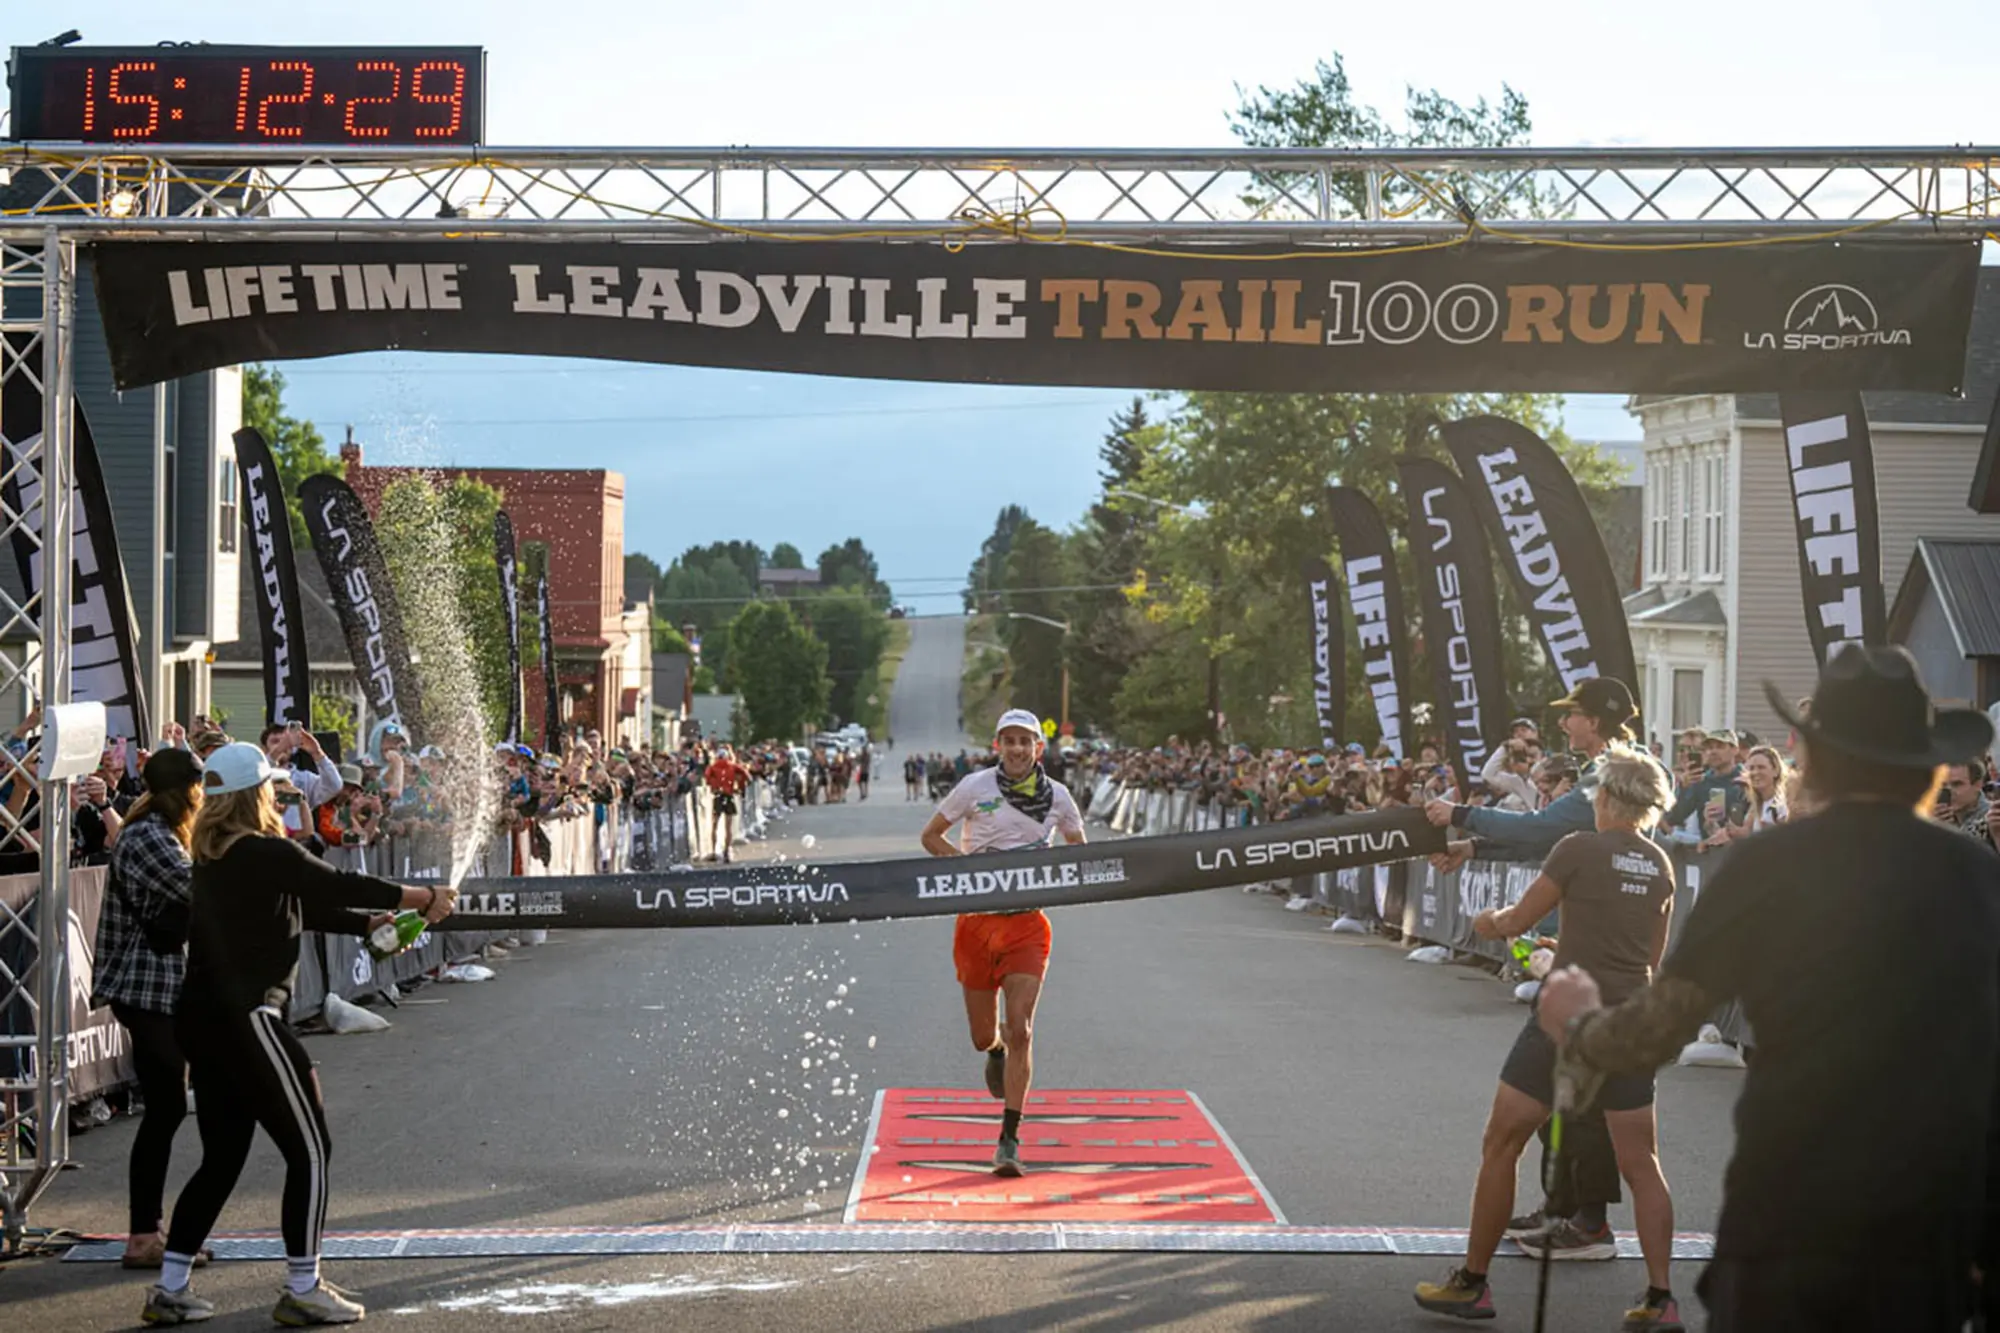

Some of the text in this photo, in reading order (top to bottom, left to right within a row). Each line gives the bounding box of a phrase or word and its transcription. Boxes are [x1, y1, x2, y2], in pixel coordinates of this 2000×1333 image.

[168, 263, 1711, 345] LIFE TIME LEADVILLE TRAIL 100 RUN
[1744, 329, 1911, 350] LA SPORTIVA
[1422, 487, 1453, 552] LA
[1787, 415, 1859, 576] LIFE
[321, 498, 351, 562] LA
[1346, 555, 1391, 650] LIFE
[917, 863, 1079, 898] LEADVILLE
[1196, 830, 1409, 870] LA SPORTIVA
[636, 882, 849, 910] LA SPORTIVA
